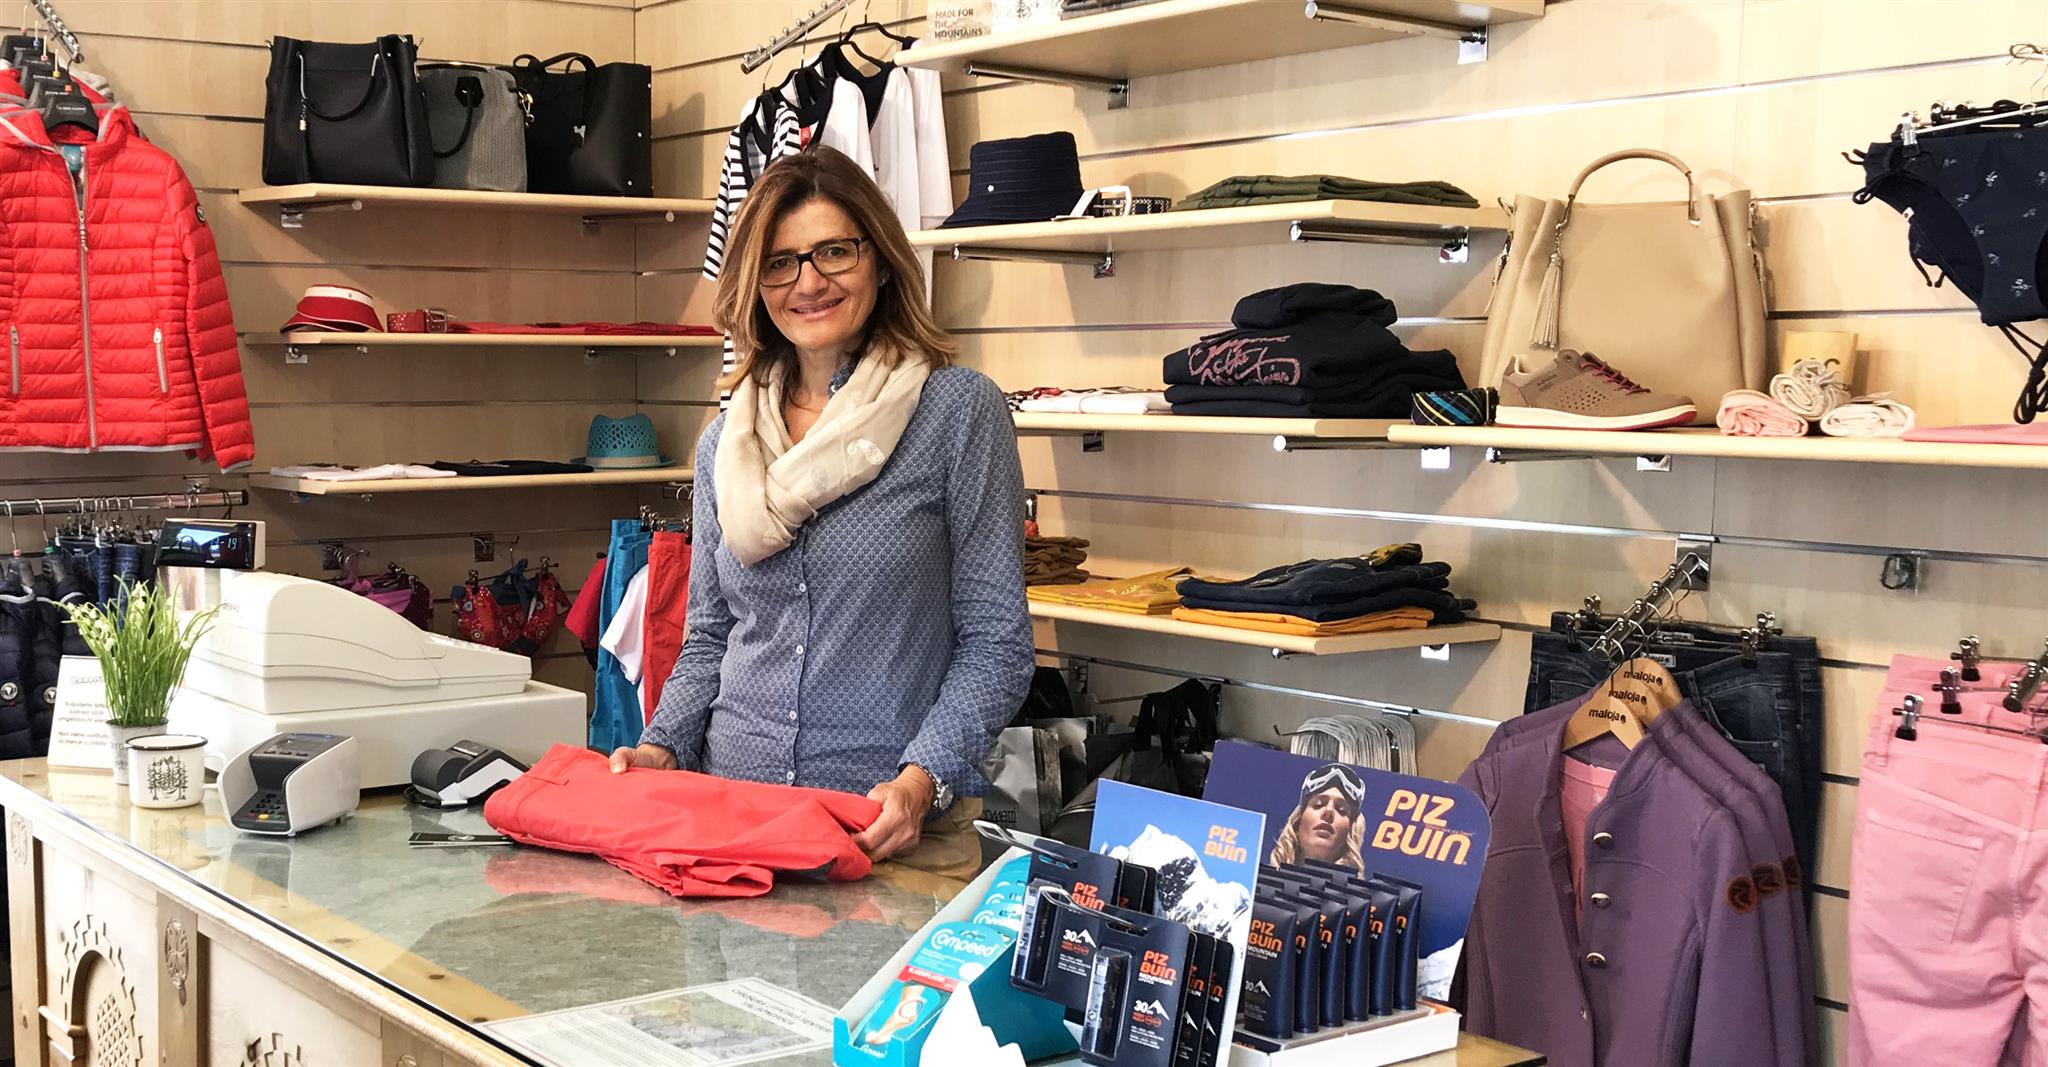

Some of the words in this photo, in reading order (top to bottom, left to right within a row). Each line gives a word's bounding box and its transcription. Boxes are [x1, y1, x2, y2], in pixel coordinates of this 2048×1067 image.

[935, 9, 956, 18] MADE
[958, 9, 974, 17] FOR
[934, 28, 983, 39] MOUNTAINS
[1623, 671, 1656, 684] maloja
[1608, 690, 1641, 702] maloja
[1589, 709, 1620, 721] maloja
[1384, 789, 1455, 828] PIZ
[1208, 825, 1239, 845] PIZ
[1372, 820, 1471, 865] BUIN
[1203, 841, 1247, 864] BUIN
[1073, 881, 1099, 896] PIZ
[1062, 929, 1076, 942] 30
[1251, 920, 1276, 936] PIZ
[931, 928, 994, 957] Compeed
[1248, 934, 1282, 952] BUIN
[1144, 950, 1169, 965] PIZ
[1140, 962, 1177, 979] BUIN
[1139, 972, 1173, 986] MOUNTAIN
[1133, 1000, 1148, 1013] 30
